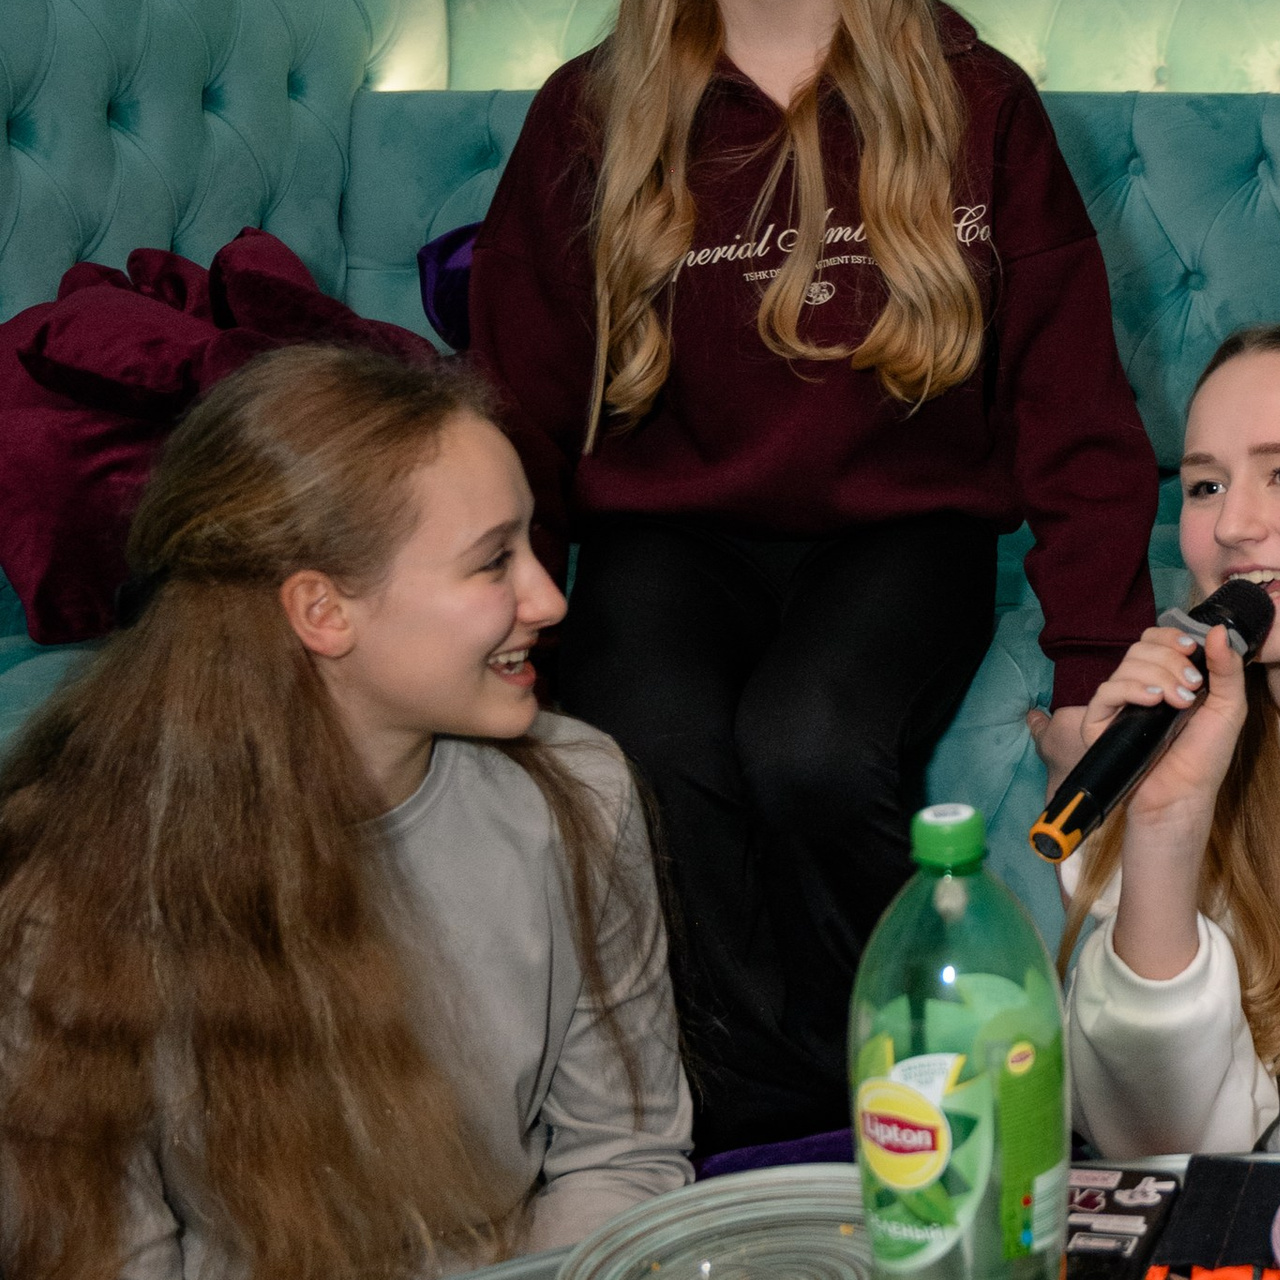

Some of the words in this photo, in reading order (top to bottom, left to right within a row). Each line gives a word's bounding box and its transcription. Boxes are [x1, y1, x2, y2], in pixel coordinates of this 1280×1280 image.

[671, 223, 776, 283] perial
[850, 254, 868, 265] EST
[864, 1114, 933, 1147] Lipton
